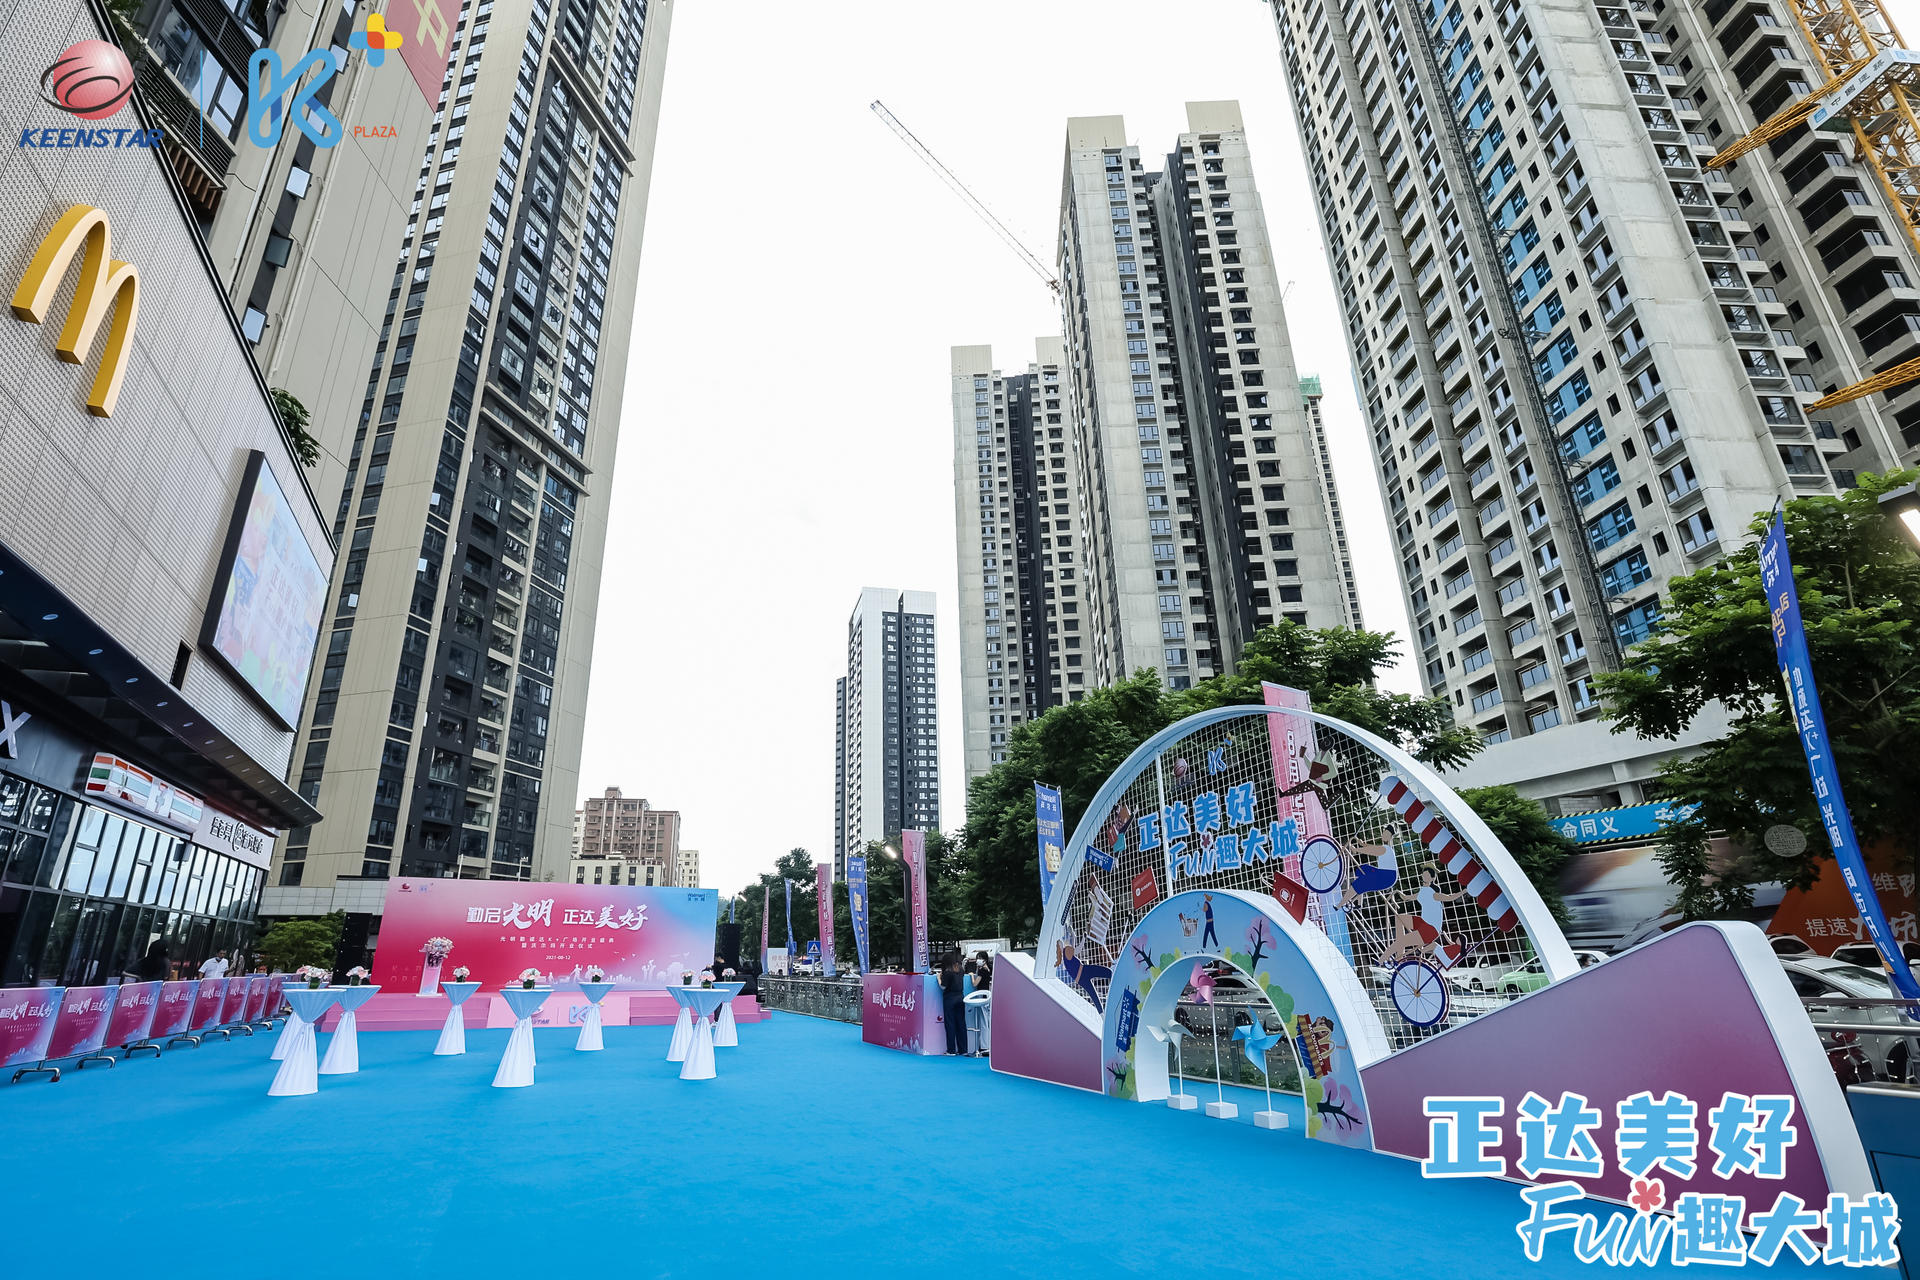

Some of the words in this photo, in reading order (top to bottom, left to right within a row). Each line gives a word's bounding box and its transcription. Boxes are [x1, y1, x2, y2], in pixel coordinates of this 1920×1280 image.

[1138, 780, 1257, 853] 正达美好
[1551, 815, 1619, 839] 命同义
[562, 904, 649, 931] 正达美好
